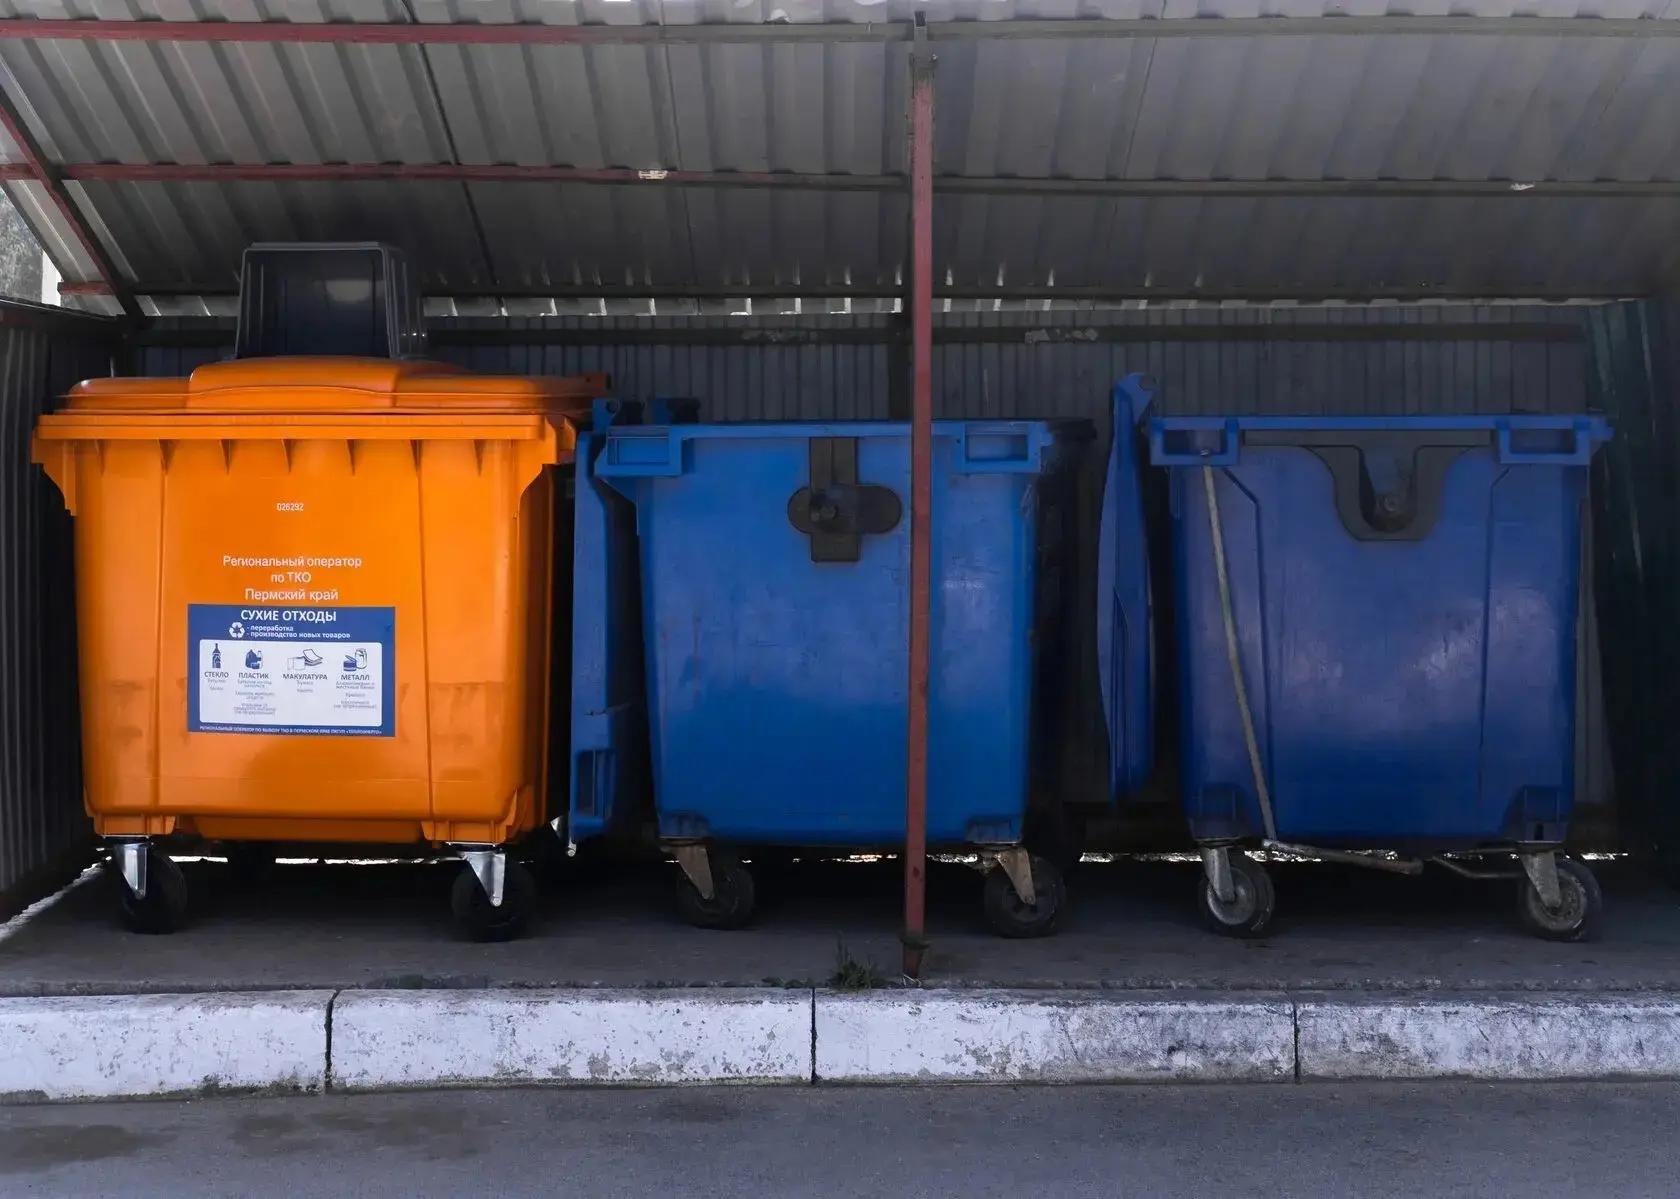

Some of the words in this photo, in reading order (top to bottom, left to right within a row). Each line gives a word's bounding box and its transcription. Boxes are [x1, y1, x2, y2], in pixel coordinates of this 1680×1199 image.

[223, 555, 304, 567] Региональный
[307, 557, 362, 568] оператор
[271, 574, 285, 583] по
[287, 572, 312, 583] ТКО
[245, 588, 305, 602] Пермский
[309, 588, 339, 602] край
[240, 609, 279, 621] СУХИЕ
[282, 610, 337, 624] ОТХОДЫ
[250, 624, 294, 632] переработка
